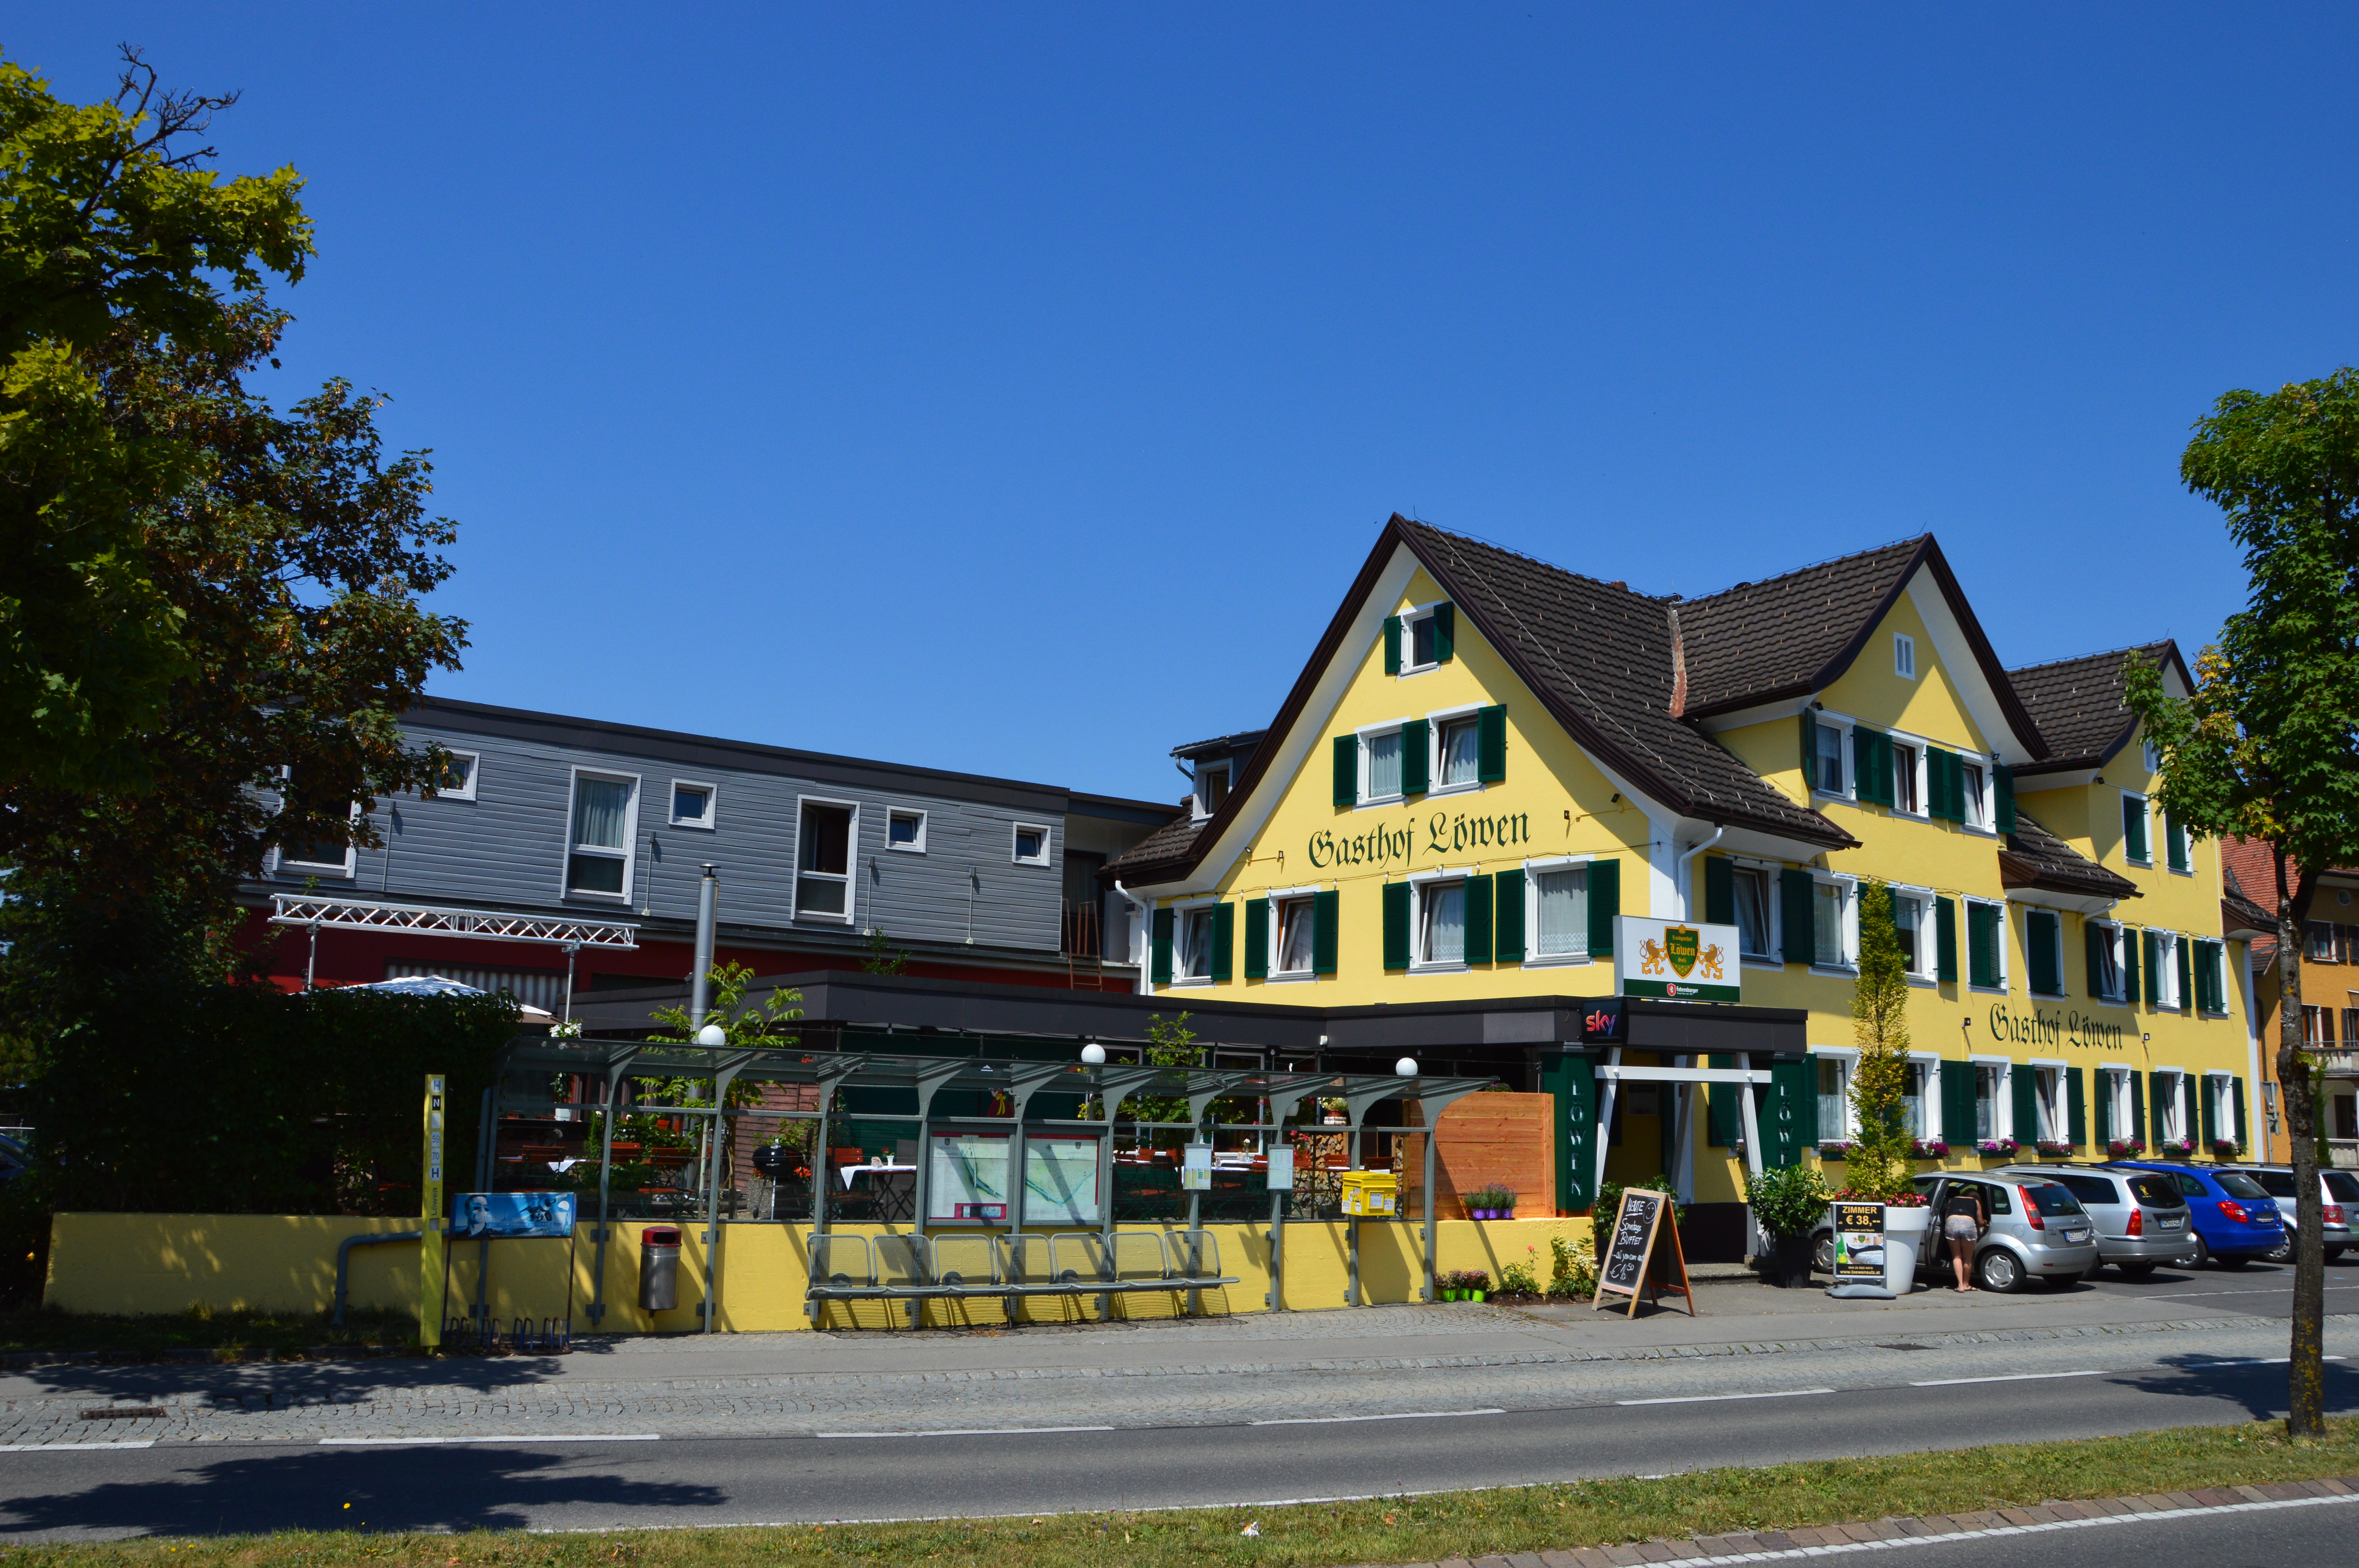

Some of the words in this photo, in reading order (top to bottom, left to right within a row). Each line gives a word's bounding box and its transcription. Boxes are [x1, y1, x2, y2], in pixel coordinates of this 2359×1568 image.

[1309, 818, 1415, 869] Gasthof
[1422, 812, 1531, 855] Löwen
[1670, 943, 1695, 956] Löwen
[1586, 1010, 1616, 1036] sky
[1990, 1003, 2061, 1054] Gasthof
[2066, 1010, 2123, 1050] Löwen
[434, 1080, 441, 1091] H
[433, 1099, 440, 1107] N
[1778, 1081, 1794, 1165] LÖWE
[1569, 1078, 1586, 1196] LÖWEN
[432, 1168, 439, 1178] H
[1627, 1198, 1646, 1212] HEUTE
[1846, 1215, 1853, 1225] €
[1618, 1231, 1643, 1245] BUFFET
